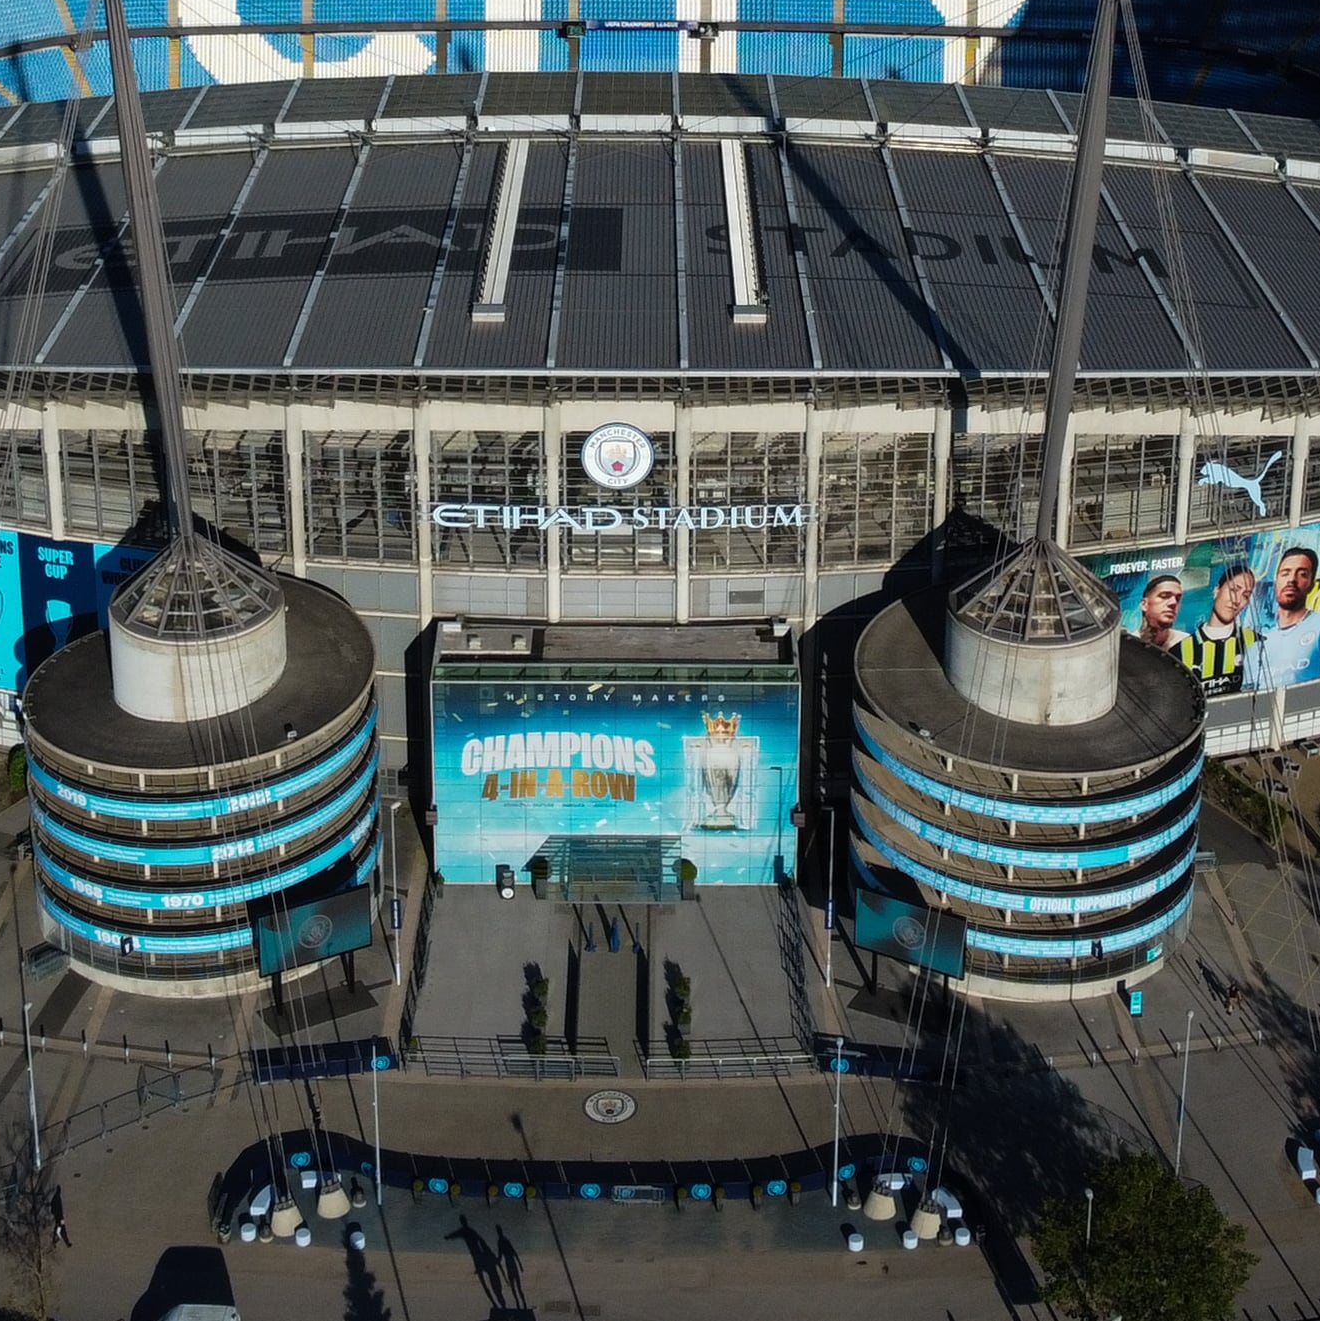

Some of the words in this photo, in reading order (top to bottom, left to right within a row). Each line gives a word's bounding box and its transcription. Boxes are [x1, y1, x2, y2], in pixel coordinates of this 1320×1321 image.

[589, 428, 646, 450] MANCHESTER
[606, 477, 628, 486] CITY
[433, 504, 623, 531] ETIHAD
[633, 504, 804, 531] STADIUM
[37, 546, 74, 566] SUPER
[1110, 560, 1150, 576] FOREVER.
[1151, 556, 1185, 571] FASTER.
[44, 564, 68, 580] CUP
[506, 693, 611, 702] HISTORY
[632, 693, 726, 702] MAKERS
[460, 732, 656, 776] CHAMPIONS
[56, 784, 87, 807] 2019
[161, 894, 204, 907] 1970
[1030, 897, 1071, 912] OFFICIAL
[1075, 890, 1132, 911] SUPPORTERS
